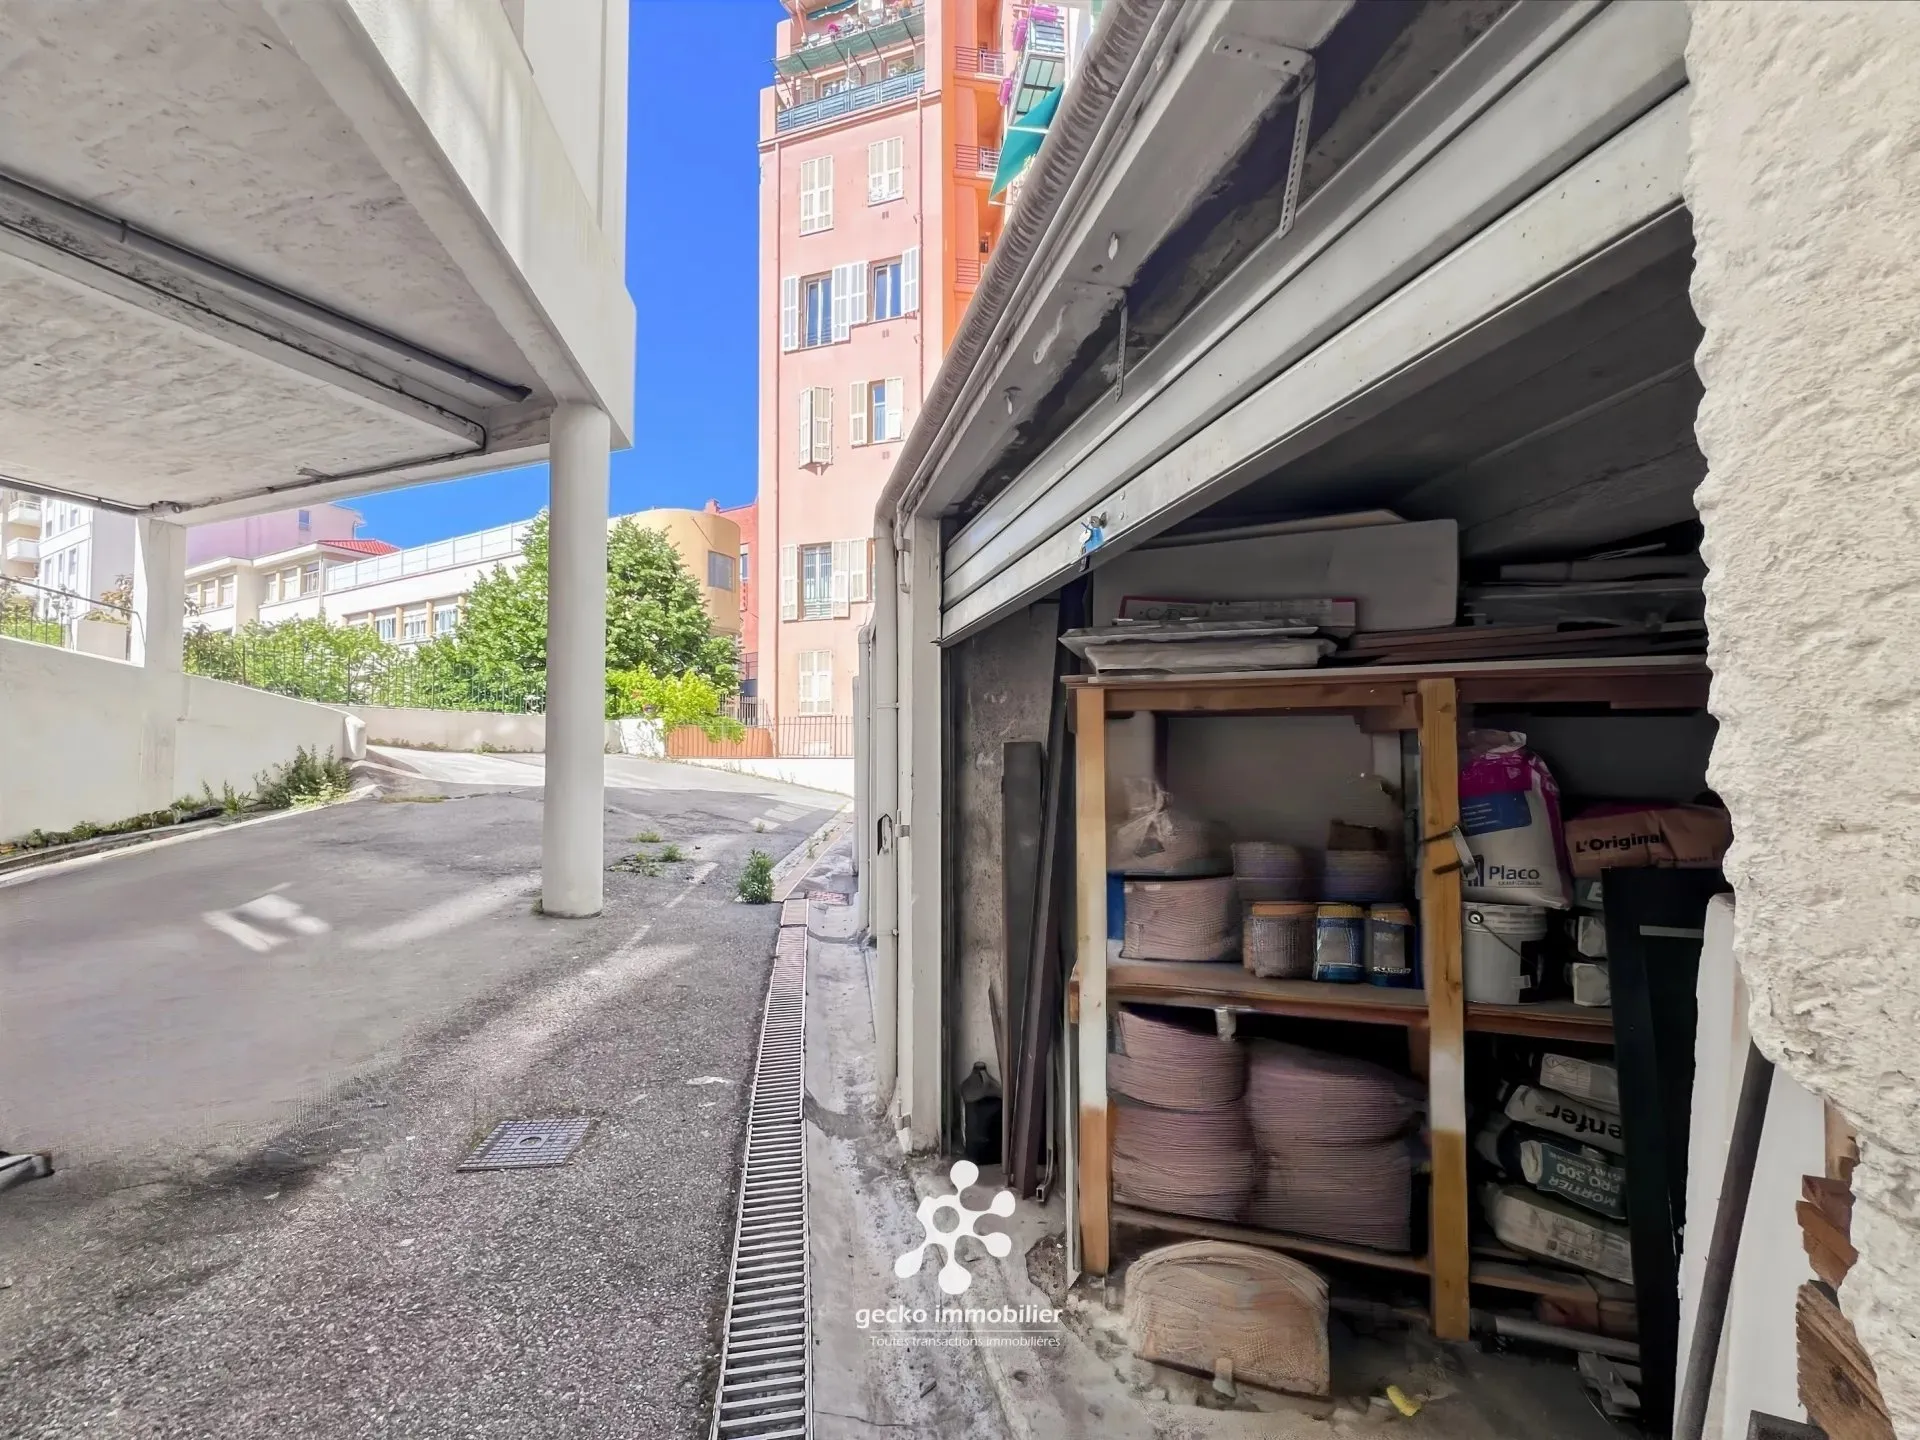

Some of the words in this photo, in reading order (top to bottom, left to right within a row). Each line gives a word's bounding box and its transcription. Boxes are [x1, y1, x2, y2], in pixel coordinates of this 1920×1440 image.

[1576, 833, 1665, 853] L'Original
[1489, 864, 1540, 880] Placo
[1557, 1163, 1585, 1182] 300
[1548, 1175, 1616, 1206] MORTIER
[1589, 1176, 1619, 1194] PRO
